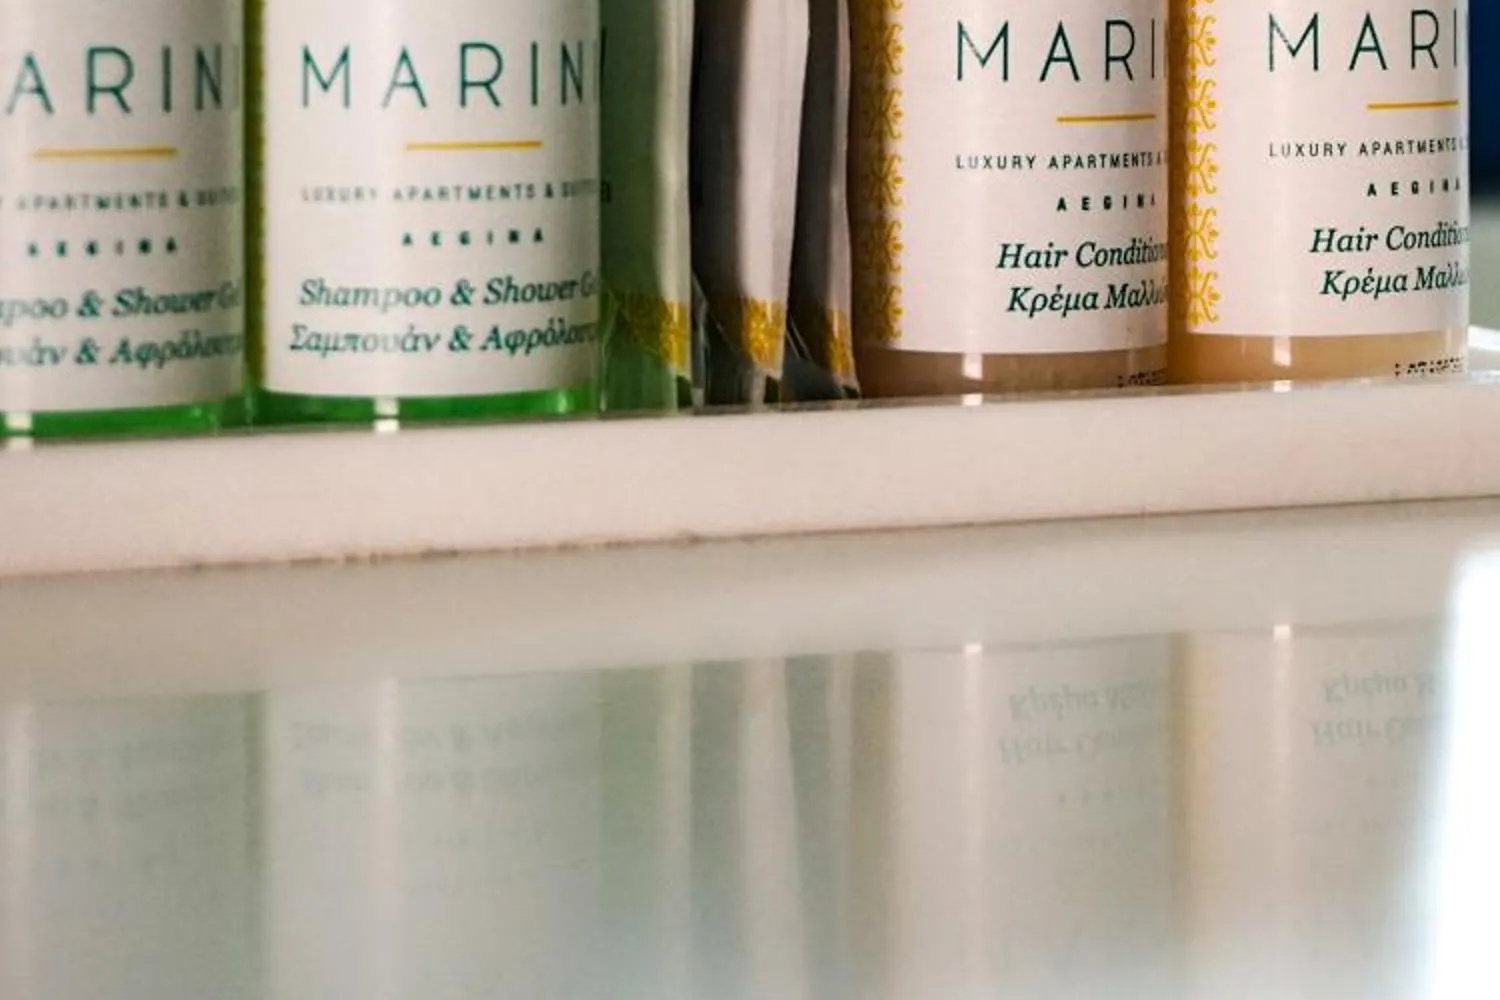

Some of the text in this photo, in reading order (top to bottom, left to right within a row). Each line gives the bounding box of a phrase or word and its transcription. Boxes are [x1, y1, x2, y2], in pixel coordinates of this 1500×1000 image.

[956, 18, 1167, 81] MARI
[1269, 8, 1467, 72] MARI
[5, 44, 240, 115] ARIN
[302, 40, 602, 108] MARIN
[956, 155, 1036, 170] LUXURY
[1047, 152, 1153, 170] APARTMENTS
[1269, 137, 1457, 158] LUXURY APARTMENTS
[996, 242, 1068, 269] Hair
[1309, 226, 1379, 253] Hair
[299, 276, 442, 314] Shampoo
[450, 277, 475, 306] &
[483, 275, 580, 305] Shower
[1320, 267, 1407, 301] Κρέμα
[76, 289, 105, 318] &
[1006, 284, 1098, 319] Κρέμα
[74, 337, 104, 366] &
[289, 322, 441, 358] Σαμπουάν
[448, 325, 474, 353] &
